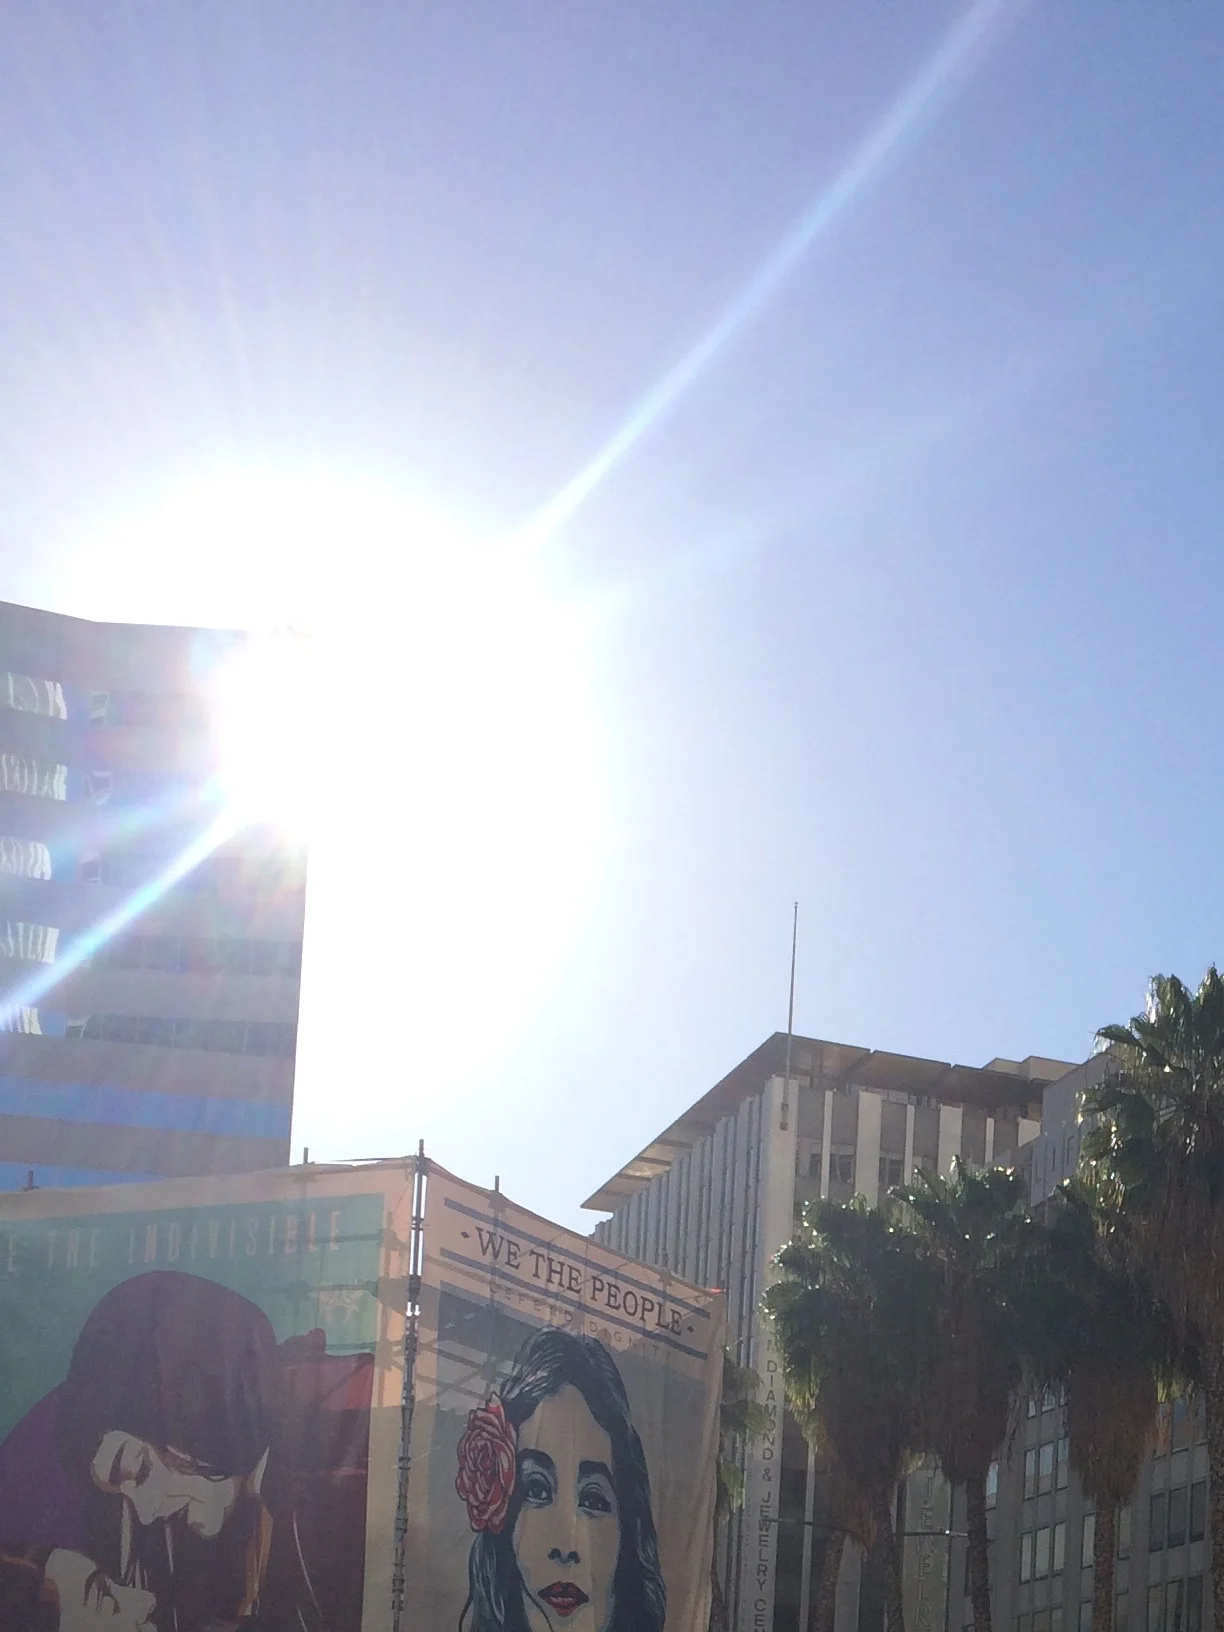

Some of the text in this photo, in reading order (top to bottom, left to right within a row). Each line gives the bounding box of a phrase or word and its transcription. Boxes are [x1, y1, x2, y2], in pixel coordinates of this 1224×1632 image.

[475, 1226, 684, 1336] WE THE PEOPLE
[757, 1491, 773, 1589] JEWELRY
